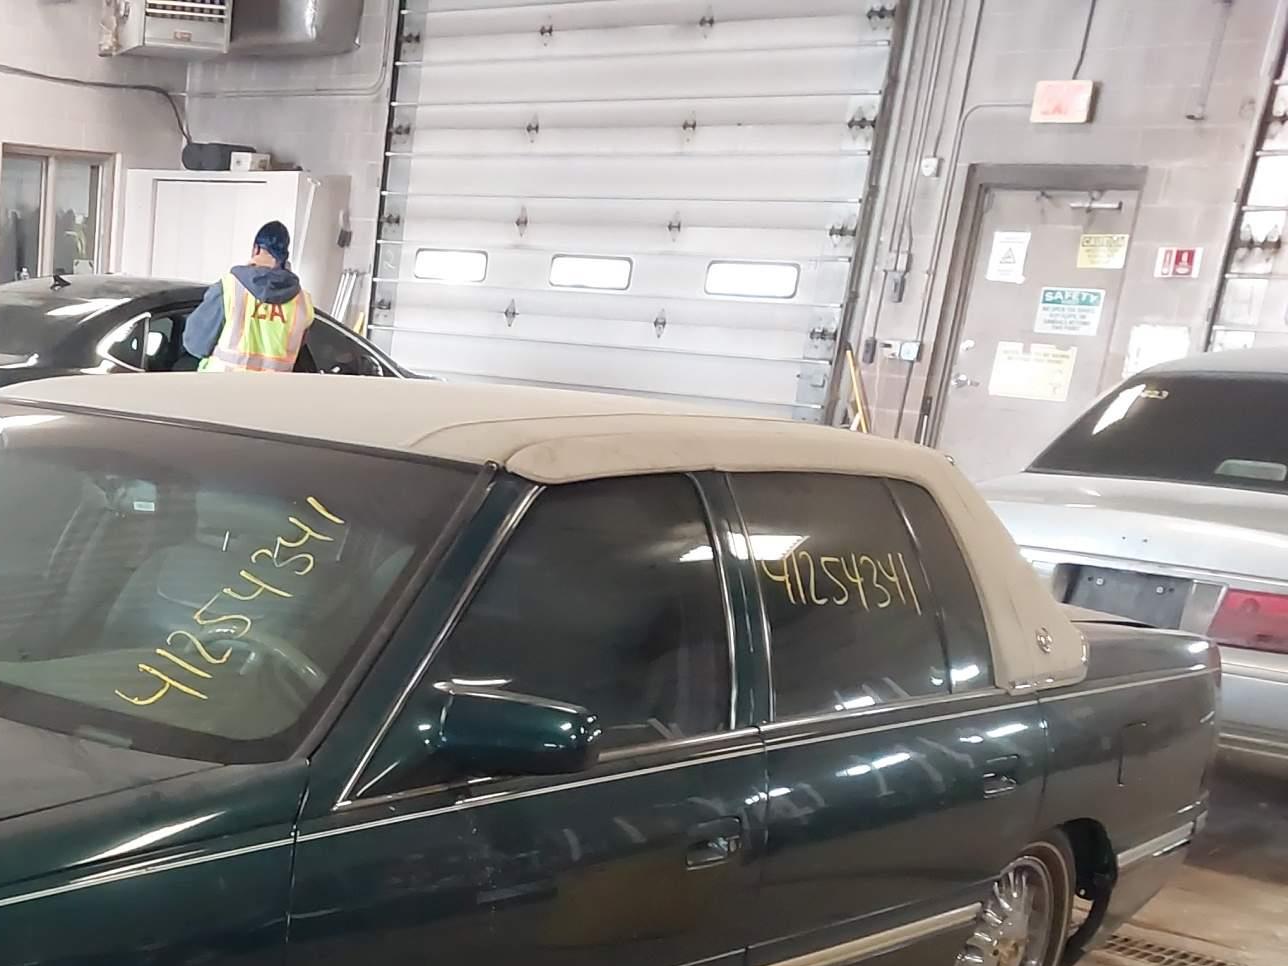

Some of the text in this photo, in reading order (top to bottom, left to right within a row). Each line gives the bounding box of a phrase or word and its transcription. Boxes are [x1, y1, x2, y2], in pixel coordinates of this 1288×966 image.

[1044, 290, 1099, 305] SAFETY
[114, 496, 346, 706] 41254341
[762, 550, 922, 616] 41254341
